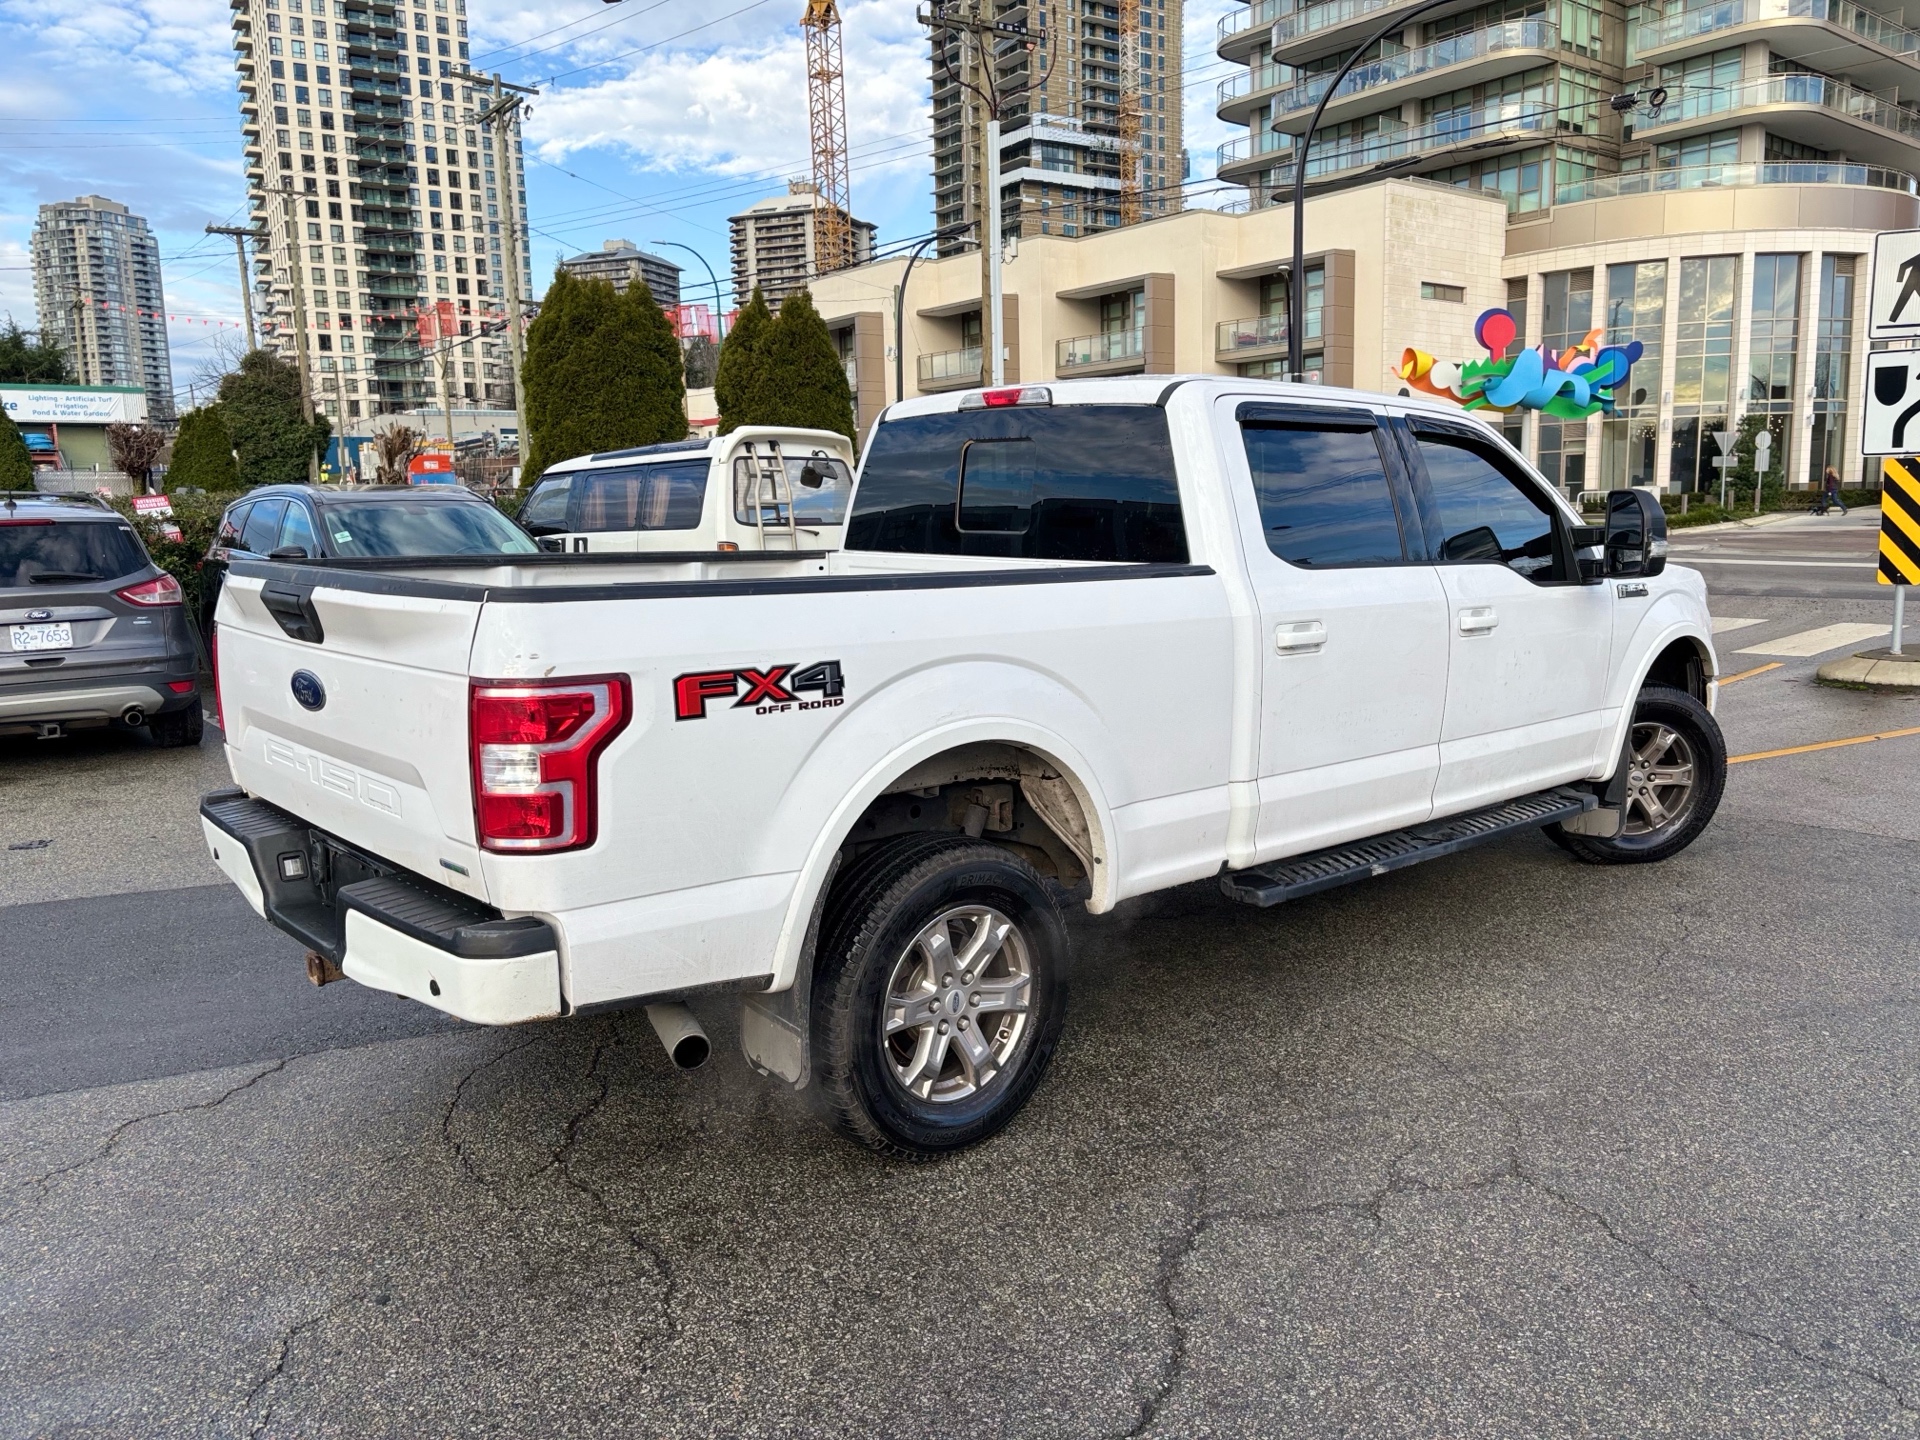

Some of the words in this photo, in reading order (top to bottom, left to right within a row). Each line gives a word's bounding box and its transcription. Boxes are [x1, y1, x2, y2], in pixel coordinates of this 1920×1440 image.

[672, 659, 845, 722] FX4
[755, 703, 792, 715] OFF
[798, 698, 845, 711] ROAD
[264, 738, 402, 819] F-150
[960, 873, 1007, 887] PRIMACY
